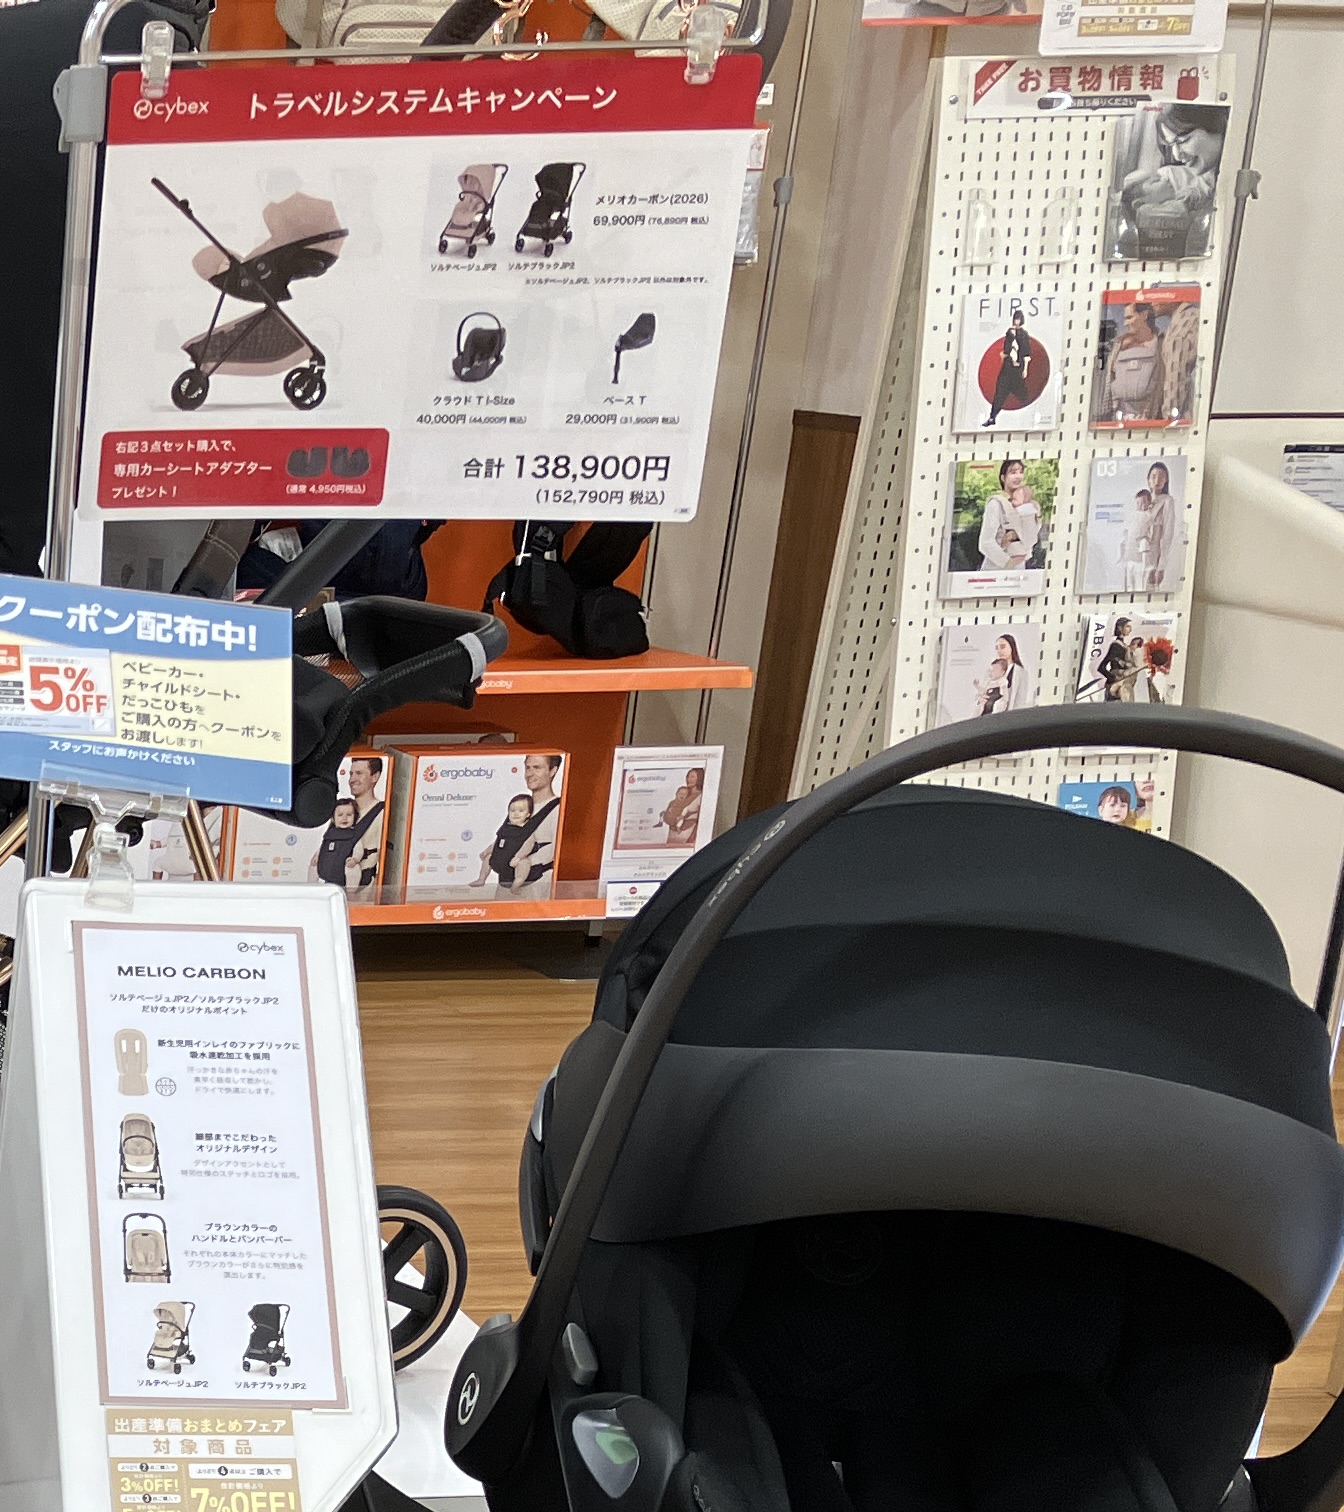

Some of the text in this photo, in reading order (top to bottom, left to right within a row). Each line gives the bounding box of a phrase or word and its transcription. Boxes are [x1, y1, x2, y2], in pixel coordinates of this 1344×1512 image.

[1018, 64, 1164, 92] お買物情報
[153, 98, 209, 121] cybex
[249, 86, 618, 120] トラベルシステムキャンペーン
[595, 193, 709, 206] メリオカーボン(2026)
[593, 214, 646, 226] 69,900円
[979, 296, 1056, 318] FIRST
[433, 395, 472, 407] クラウド
[603, 395, 635, 405] ベース
[416, 413, 466, 425] 40,000円
[565, 413, 617, 425] 29,000円
[114, 461, 273, 478] 専用カーシートアダプター
[463, 454, 671, 483] 合計 138,900円
[1096, 460, 1117, 477] 03
[535, 489, 666, 506] (152,790円 税込)
[29, 665, 95, 712] 5%
[65, 693, 108, 714] OFF
[122, 694, 205, 716] だっこひもを
[121, 711, 282, 741] ご購入の方へクーポンを
[48, 739, 196, 766] スタッフにお声かけください
[440, 767, 495, 780] ergobaby
[445, 906, 487, 918] ergobaby
[250, 942, 284, 954] cybex
[117, 965, 267, 980] MELIO CARBON
[141, 1005, 248, 1015] だけのオリジナルポイント
[157, 1038, 301, 1050] 新生児用インレイのファブリックに
[196, 1144, 278, 1154] オリジナルデザイン
[204, 1222, 279, 1233] ブラウンカラーの
[114, 1417, 288, 1434] 出産準備おまとめフェア
[152, 1438, 253, 1456] 対象商品
[120, 1477, 180, 1494] 3%OFF!
